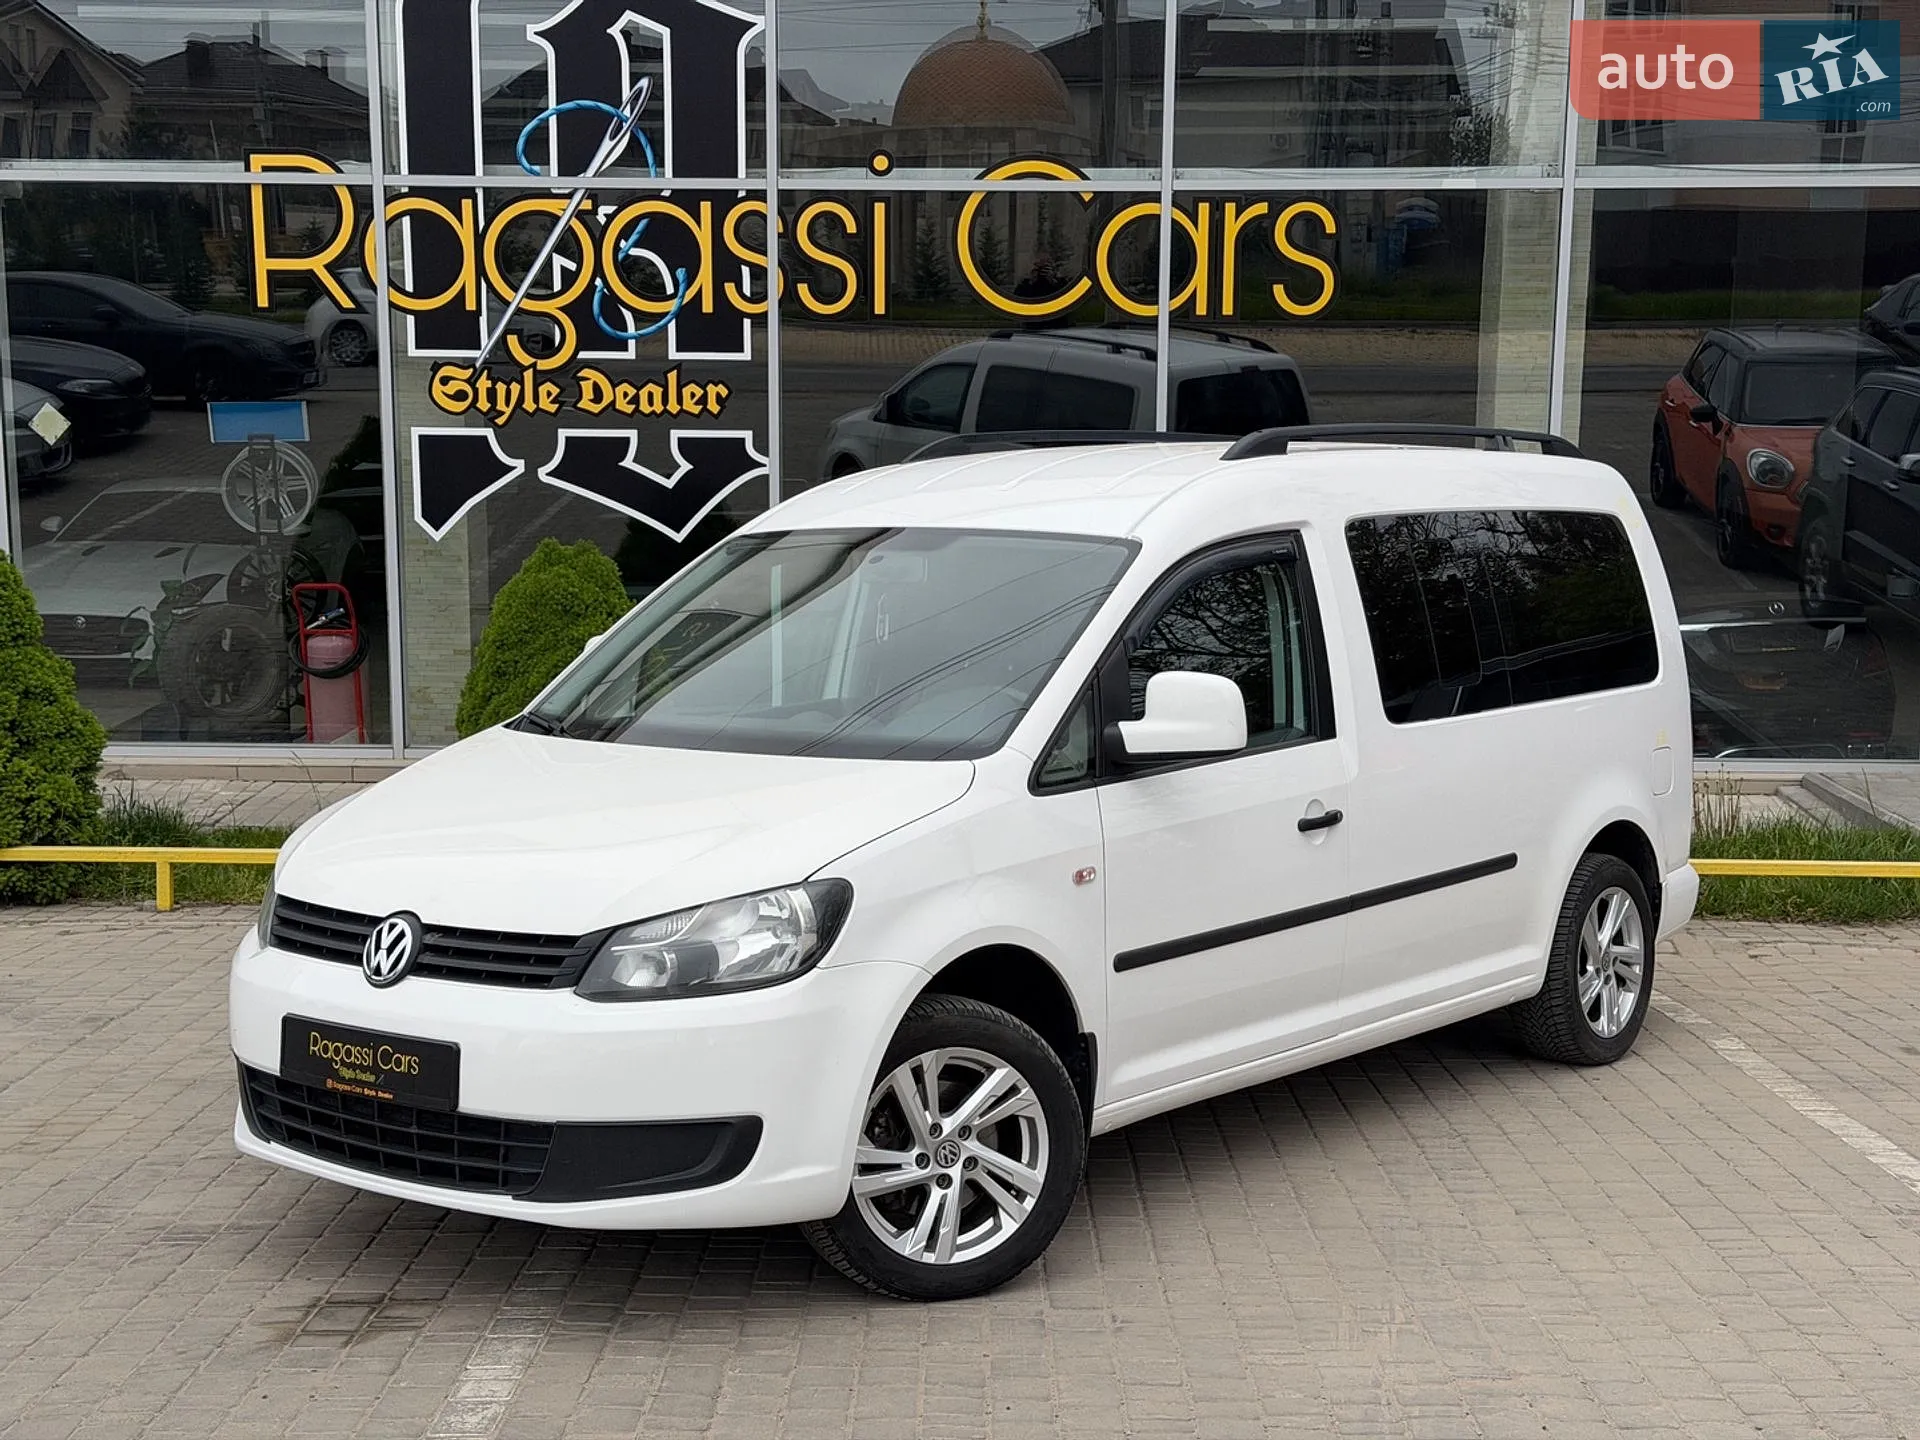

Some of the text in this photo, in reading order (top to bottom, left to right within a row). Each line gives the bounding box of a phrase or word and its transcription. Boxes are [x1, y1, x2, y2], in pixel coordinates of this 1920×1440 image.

[248, 153, 1337, 370] Ragassi Cars
[431, 364, 730, 426] Style Dealer
[309, 1031, 419, 1075] Ragassi Cars
